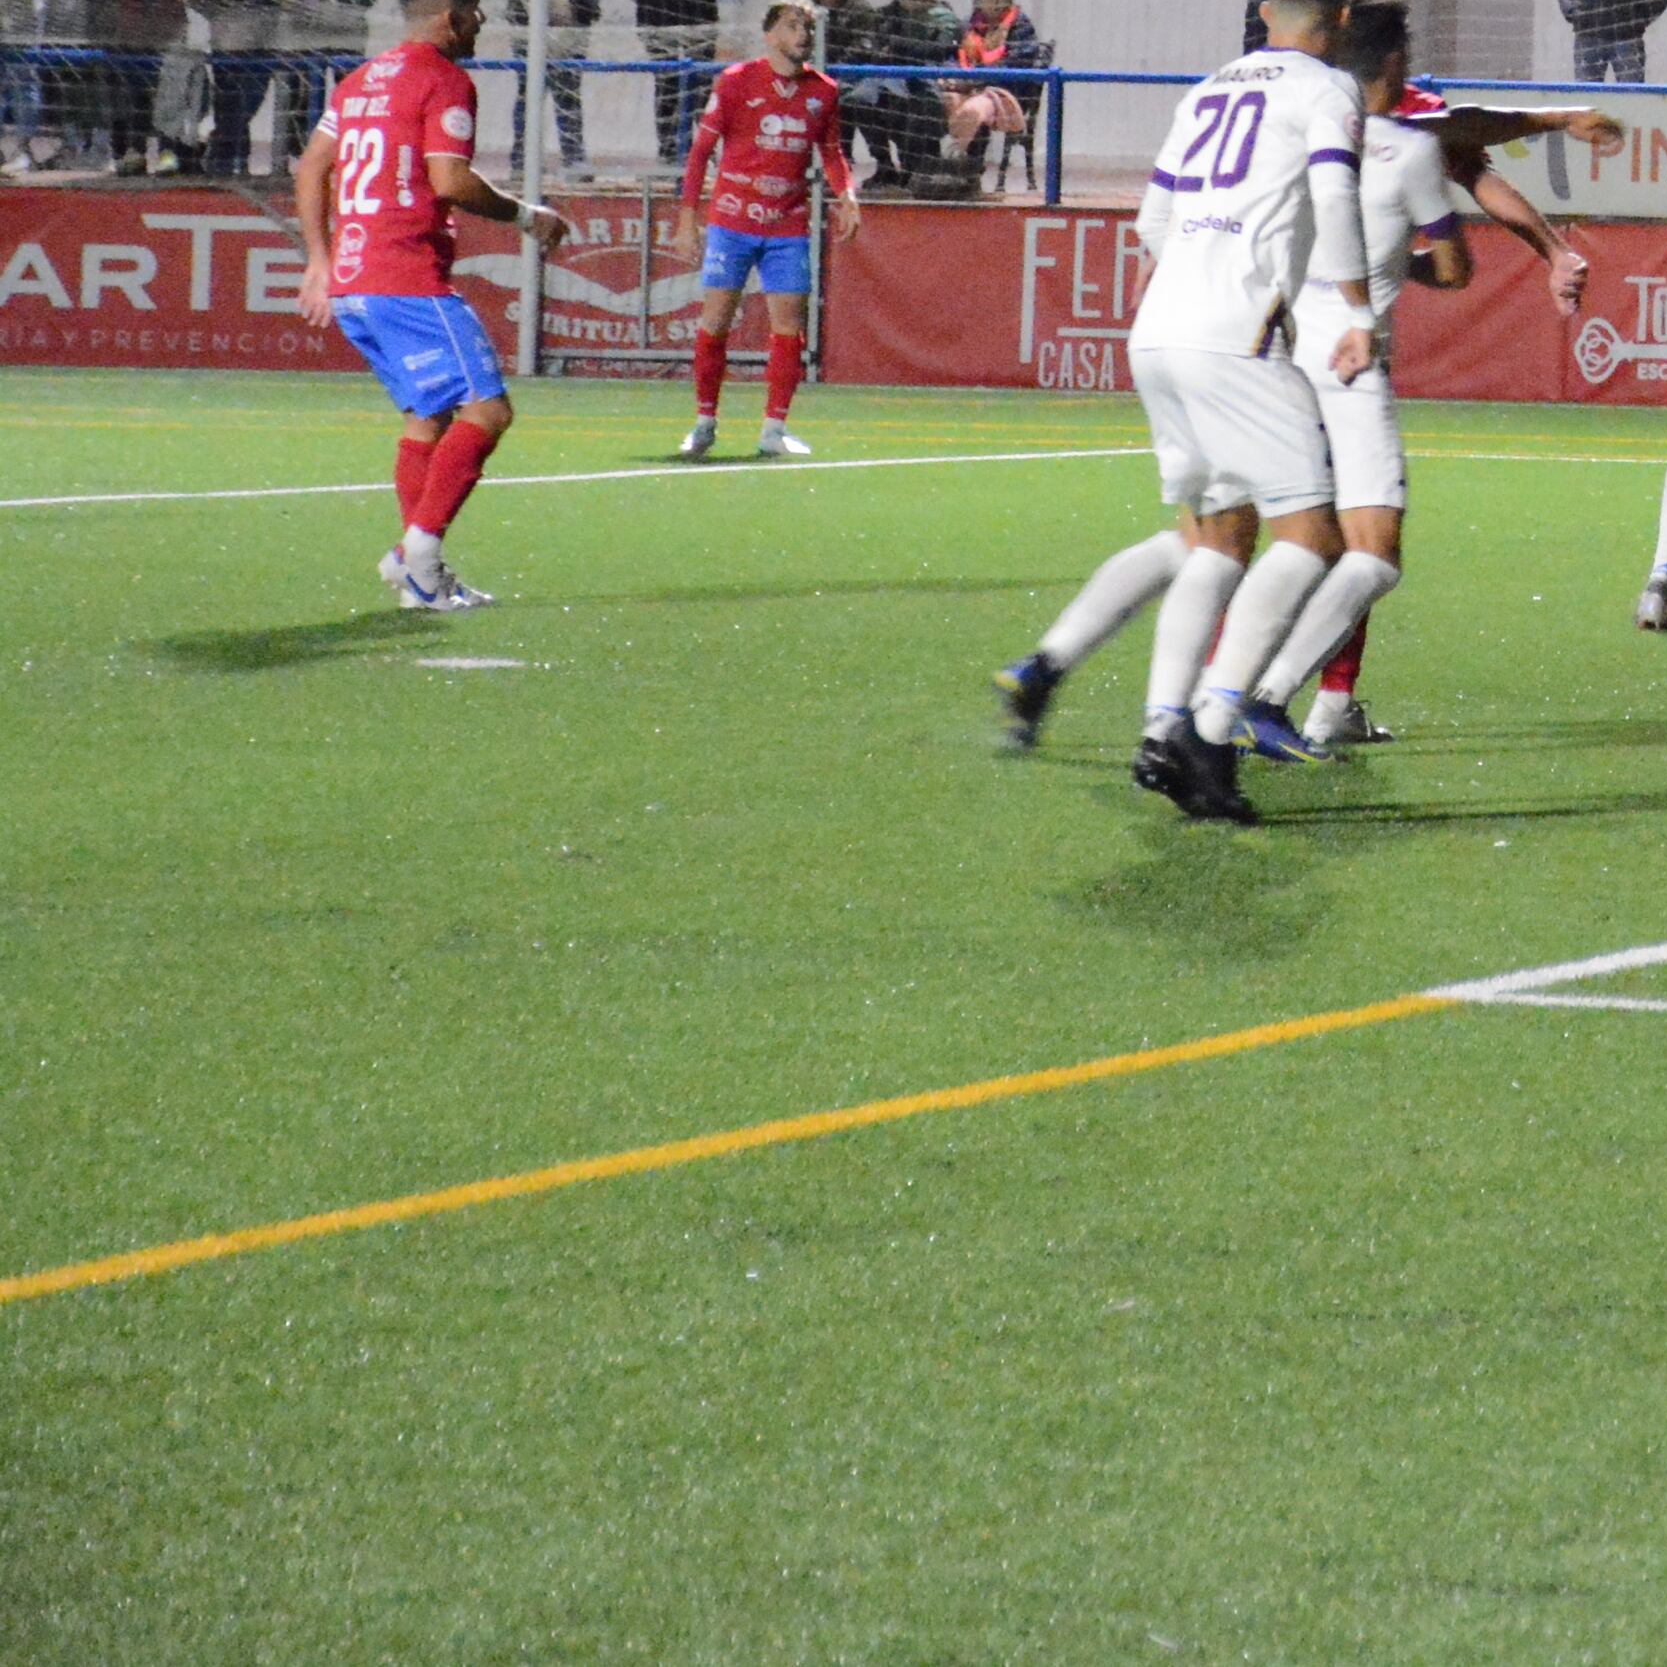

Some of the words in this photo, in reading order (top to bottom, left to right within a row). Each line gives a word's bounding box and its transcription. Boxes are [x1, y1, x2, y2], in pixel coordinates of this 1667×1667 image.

[337, 126, 386, 216] 22
[1181, 90, 1267, 194] 20
[1037, 341, 1115, 391] CASA
